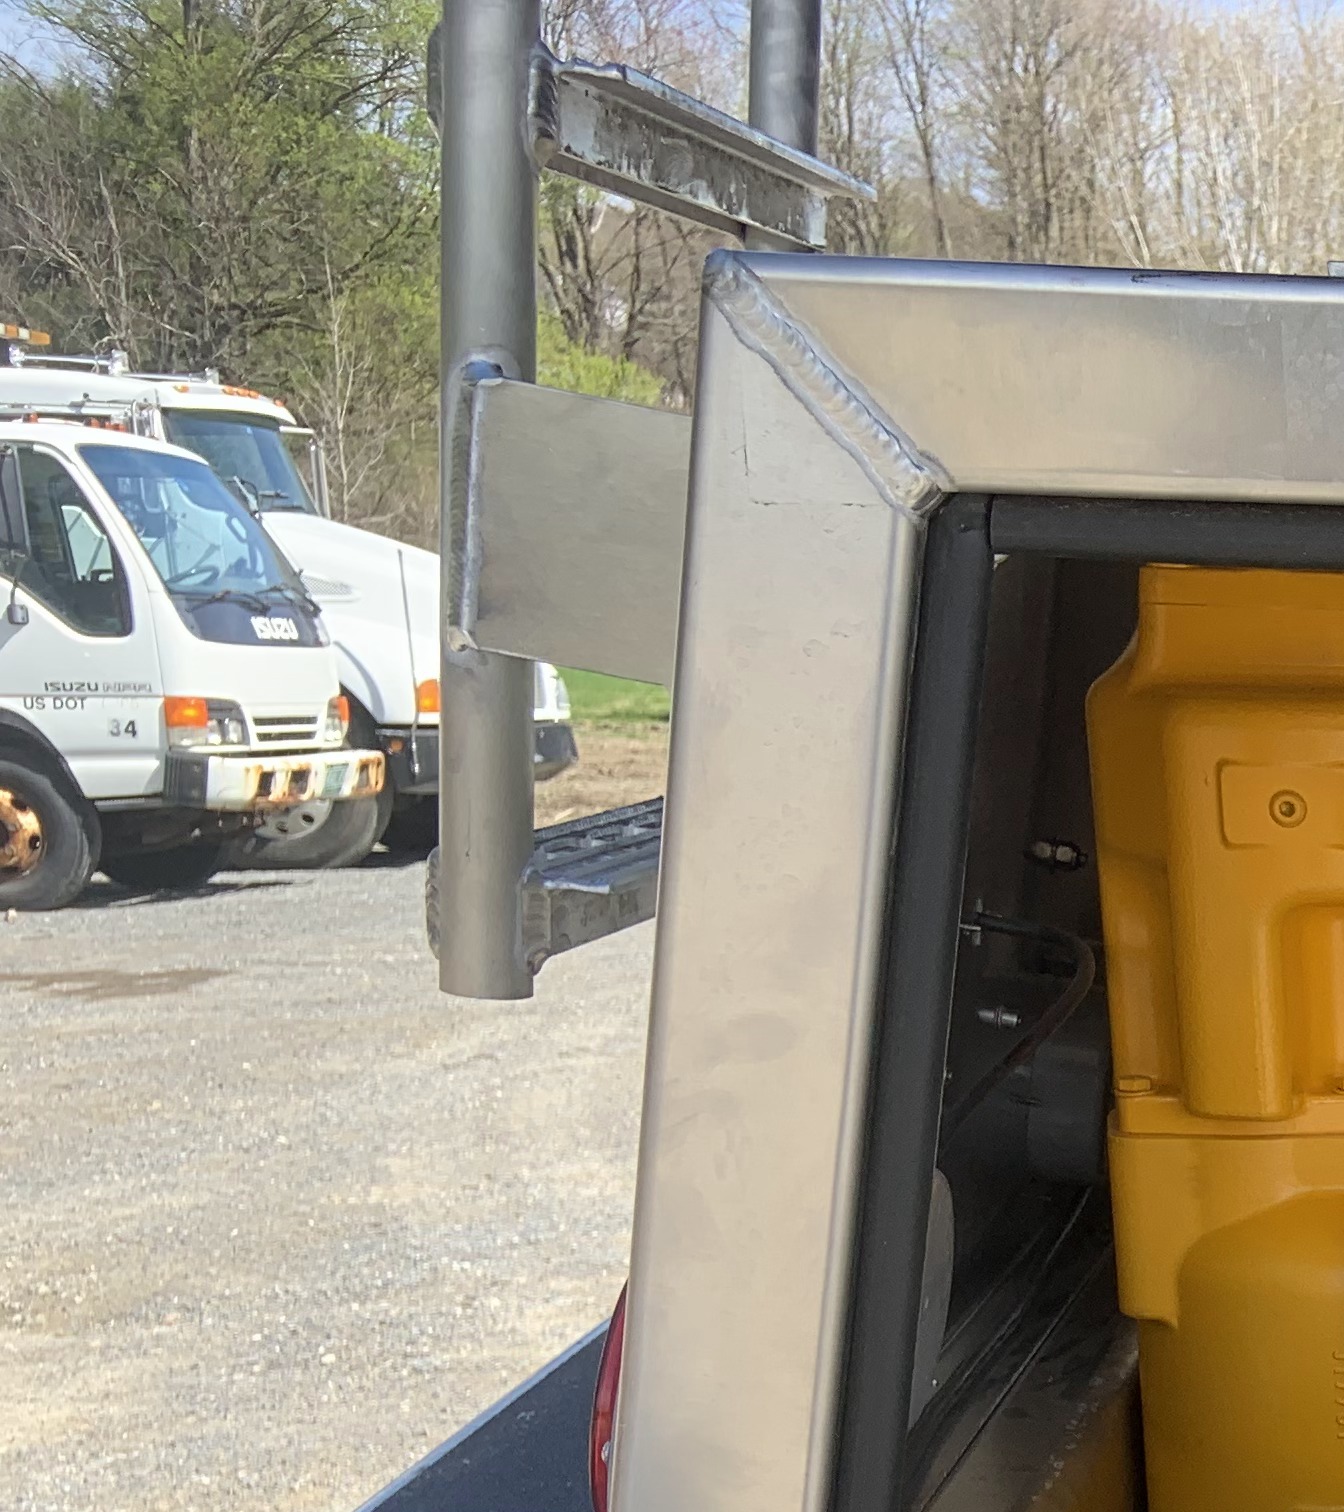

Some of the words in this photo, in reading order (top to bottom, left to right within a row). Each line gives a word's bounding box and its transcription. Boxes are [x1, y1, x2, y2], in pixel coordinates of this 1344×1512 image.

[250, 616, 299, 639] ISUZU
[44, 681, 99, 692] ISUZU
[23, 696, 46, 710] US
[52, 696, 87, 710] DOT
[110, 718, 137, 737] 34
